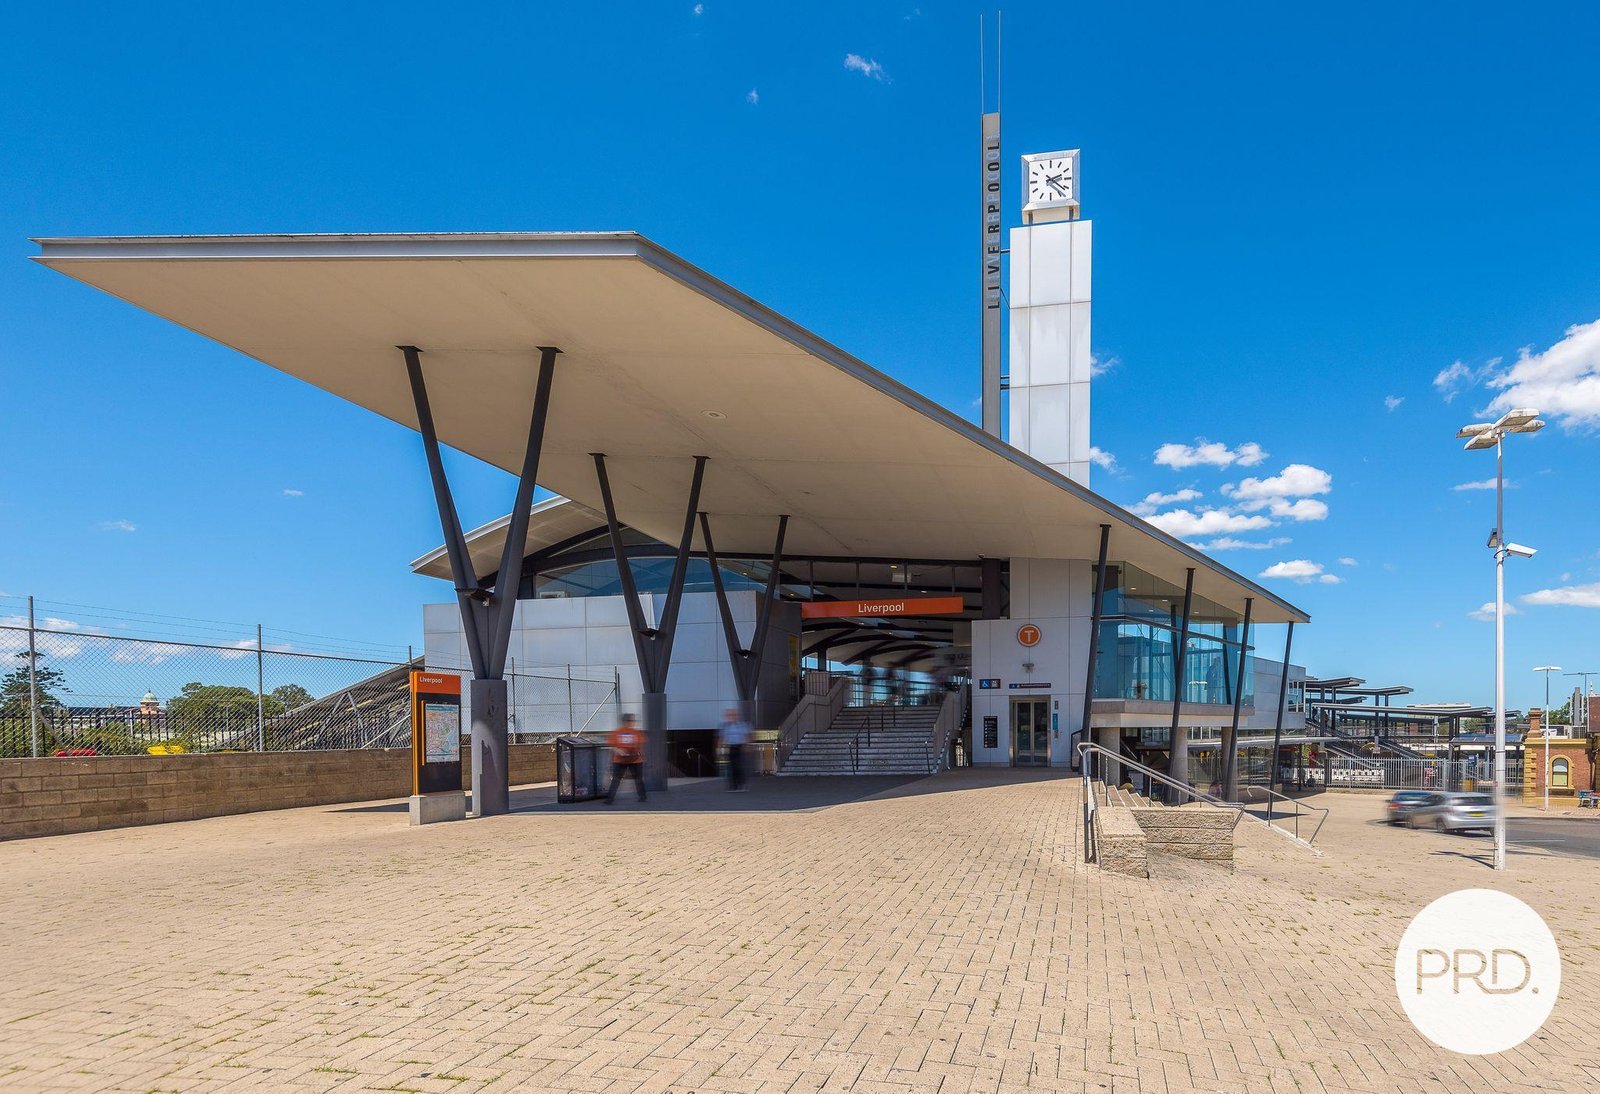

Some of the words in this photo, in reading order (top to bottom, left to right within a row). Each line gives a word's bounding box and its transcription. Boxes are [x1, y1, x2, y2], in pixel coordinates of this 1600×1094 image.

[987, 142, 1000, 310] LIVERPOOL
[858, 602, 905, 614] Liverpool
[1024, 630, 1035, 642] T
[419, 676, 443, 684] Liverpool
